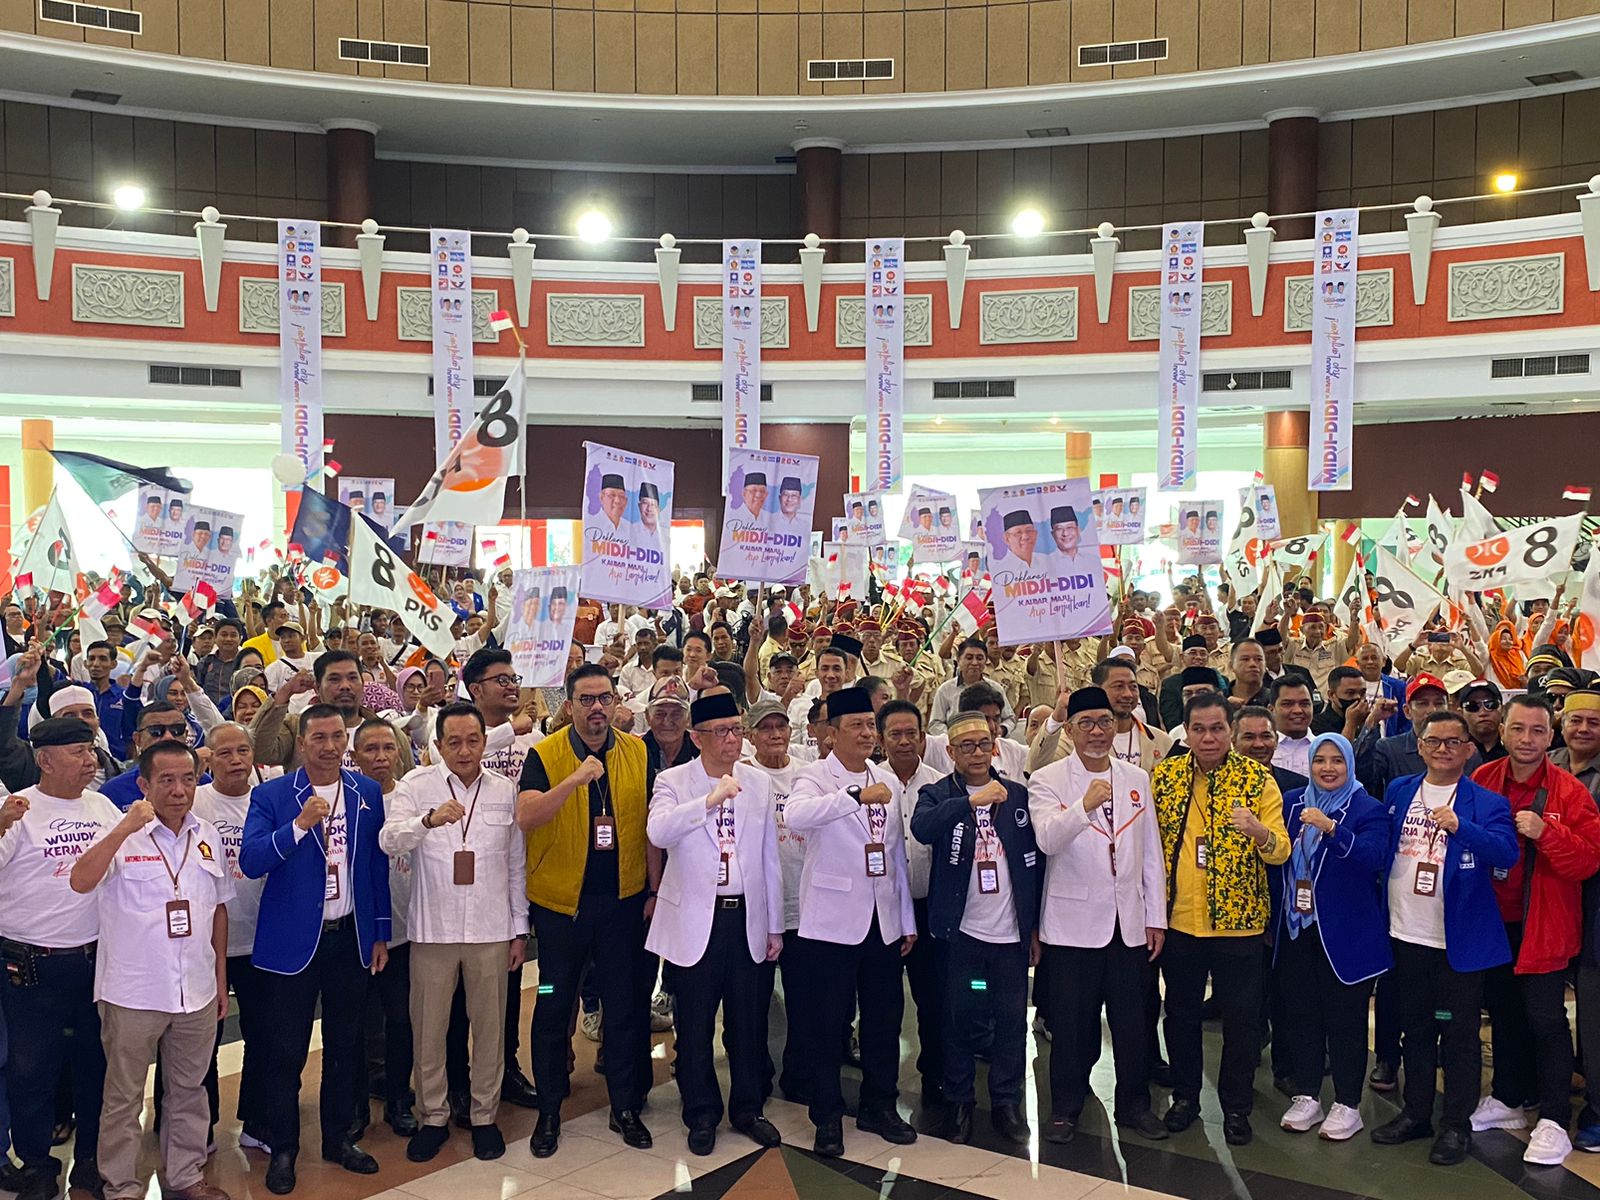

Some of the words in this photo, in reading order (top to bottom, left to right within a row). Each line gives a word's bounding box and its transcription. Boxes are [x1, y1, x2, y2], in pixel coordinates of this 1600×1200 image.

[477, 389, 518, 448] 8
[879, 413, 891, 490] MIDJI-DIDI
[1170, 405, 1185, 486] MIDJI-DIDI
[1322, 400, 1339, 484] MIDJI-DIDI
[139, 526, 183, 540] MIDJI-DIDI
[732, 530, 802, 548] MIDJI-DIDI
[592, 541, 664, 566] MIDJI-DIDI
[744, 551, 759, 567] Ayo
[761, 550, 797, 567] Lanjutkan!
[1285, 537, 1310, 555] 8
[1523, 526, 1558, 568] 8
[183, 558, 231, 575] MIDJI-DIDI
[371, 541, 396, 592] 8
[608, 566, 623, 586] Ayo
[625, 566, 661, 586] Lanjutkan!
[1004, 573, 1094, 599] MIDJI-DIDI
[1018, 597, 1048, 607] KALBAR
[1050, 594, 1071, 603] MAJU
[1029, 606, 1046, 625] Ayo
[1049, 593, 1091, 618] Lanjutkan!
[405, 597, 443, 631] PKS
[511, 640, 565, 653] MIDJI-DIDI
[43, 844, 83, 858] KERJA
